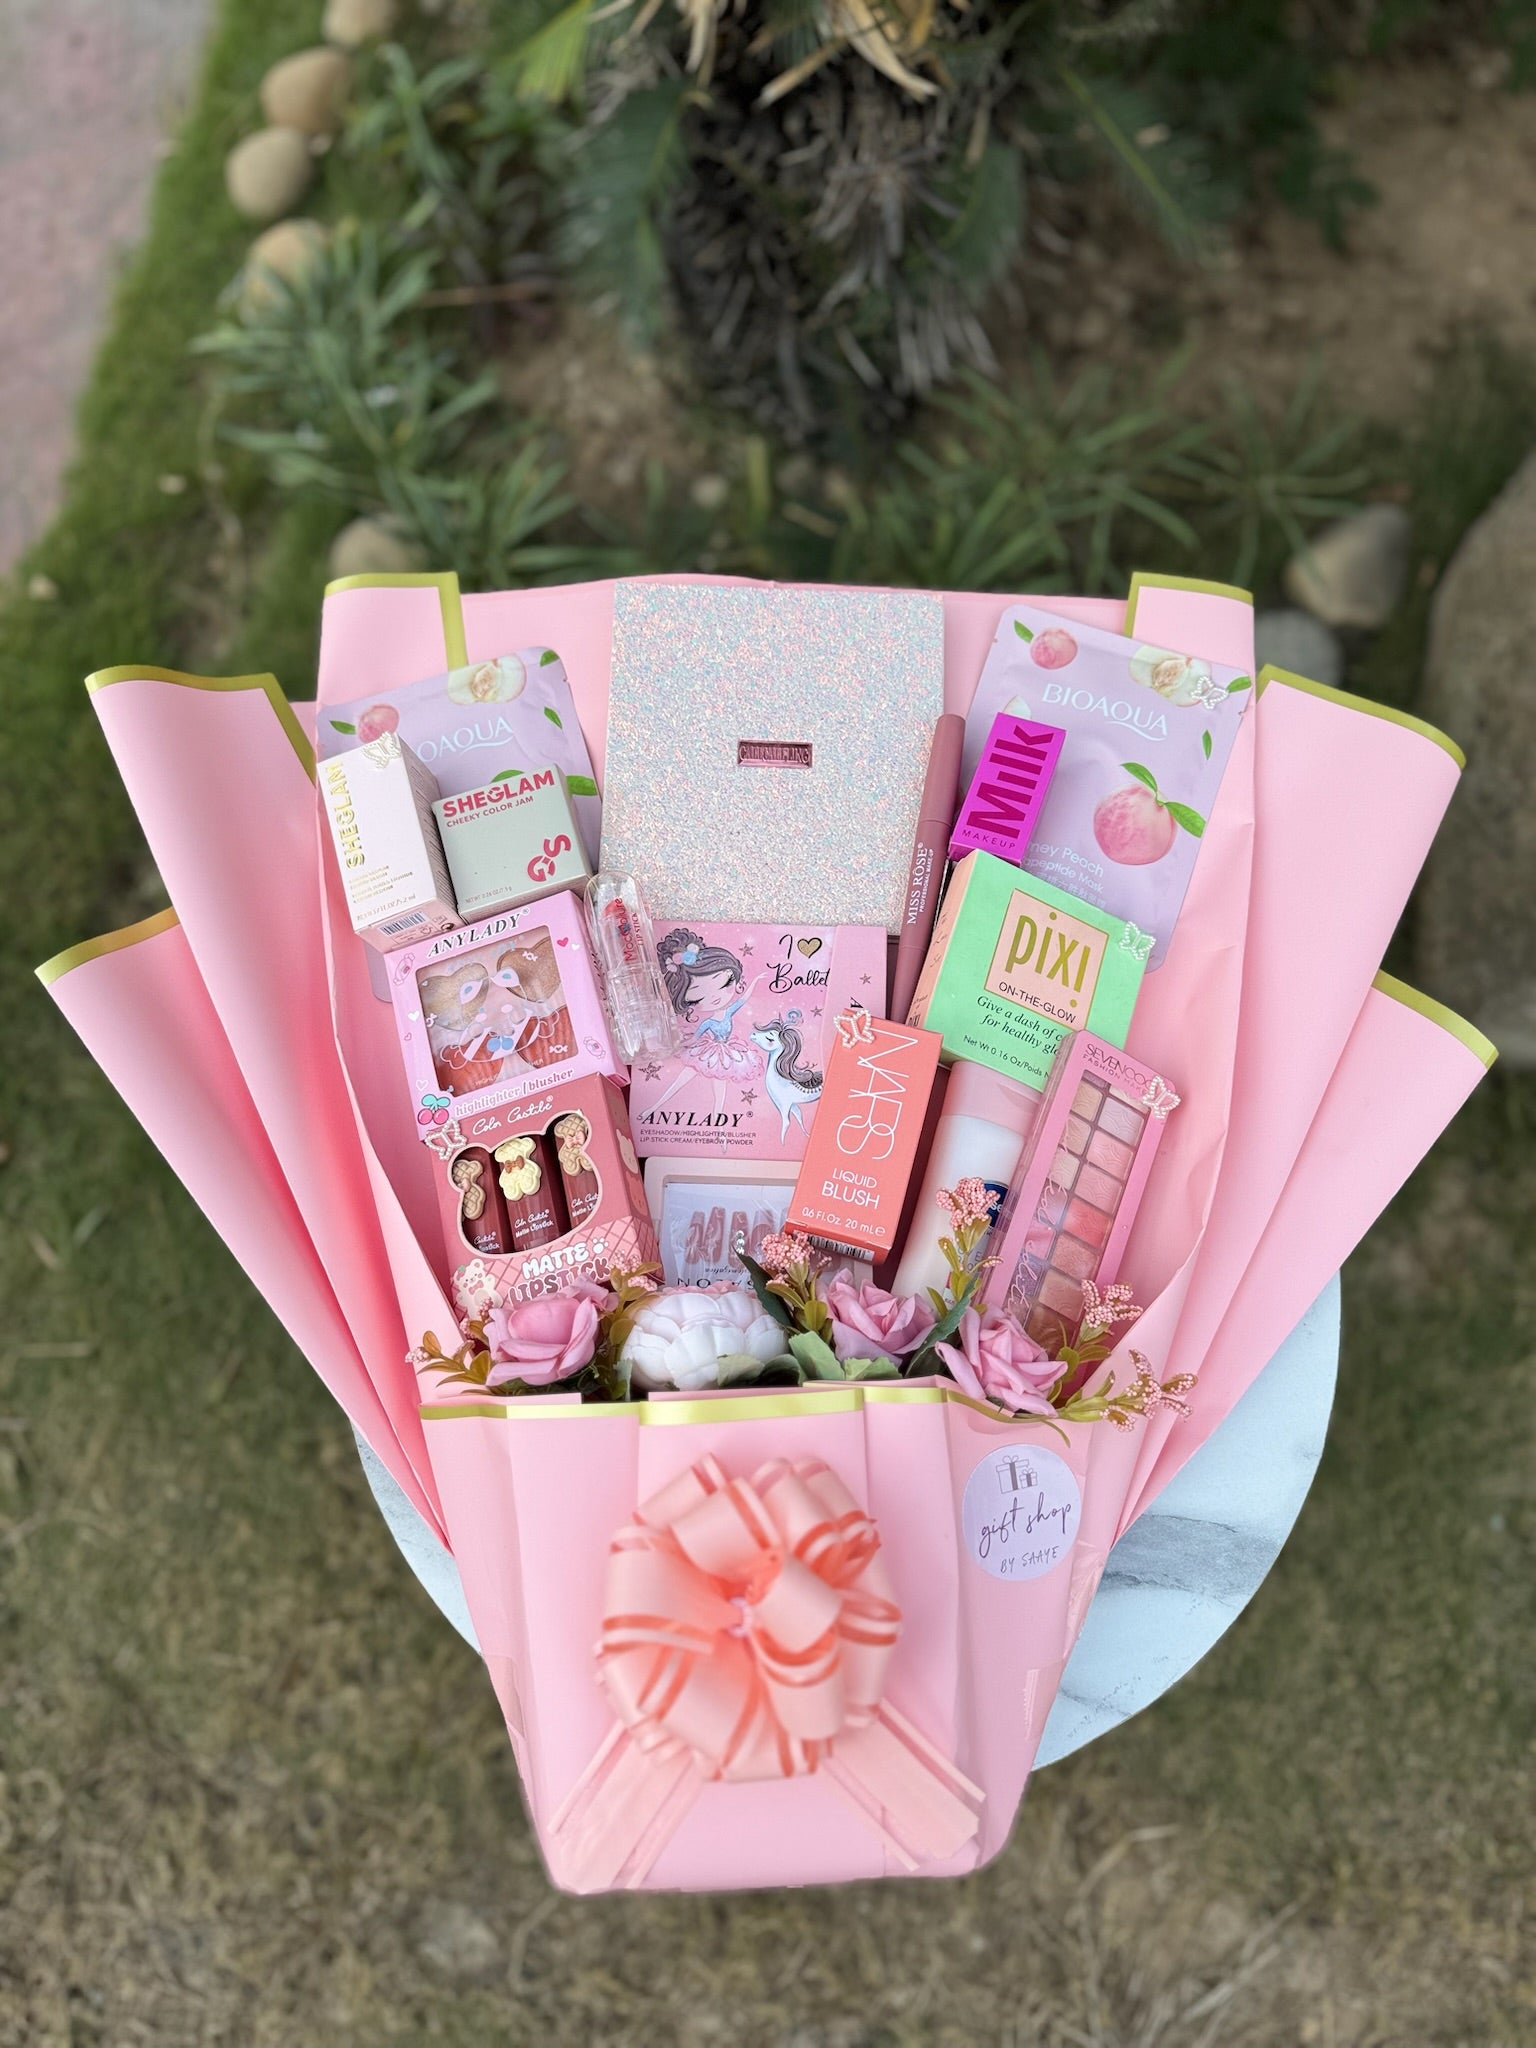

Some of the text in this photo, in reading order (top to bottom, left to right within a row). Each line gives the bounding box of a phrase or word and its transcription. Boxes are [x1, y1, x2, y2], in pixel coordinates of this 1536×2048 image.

[1041, 683, 1168, 737] BIOAQUA
[415, 716, 514, 762] OAQUA
[443, 770, 555, 818] SHEGLAM
[966, 724, 1054, 839] Milk
[325, 760, 365, 869] SHEGLAM
[446, 795, 534, 828] CHEEKY COLOR JAM
[961, 829, 1017, 850] MAKEUP
[1031, 843, 1104, 878] ney Peach
[1079, 872, 1104, 894] Mask
[907, 890, 920, 925] MISS
[427, 913, 522, 958] ANYLADY
[766, 962, 831, 993] Ballet
[977, 995, 1003, 1014] Give
[1004, 1010, 1013, 1019] a
[1014, 1013, 1041, 1032] dash
[1042, 1028, 1057, 1039] of
[998, 981, 1077, 1024] ON-THE-GLOW
[979, 1014, 1001, 1027] for
[1002, 1022, 1042, 1049] healthy
[1042, 1043, 1060, 1055] glo
[963, 1034, 978, 1046] Net
[979, 1041, 990, 1051] Wt
[990, 1047, 1008, 1060] 0.16
[1010, 1056, 1042, 1076] Oz/Poids
[1083, 1054, 1121, 1079] FASHION
[455, 1086, 521, 1117] highlighter
[528, 1068, 574, 1091] blusher
[836, 1027, 919, 1160] NARS
[641, 1111, 743, 1127] ANYLADY
[726, 1138, 754, 1146] POWDER
[821, 1180, 880, 1210] BLUSH
[832, 1167, 877, 1189] LIQUID
[845, 1218, 858, 1229] 20
[522, 1242, 590, 1280] MATTE
[978, 1491, 1072, 1559] gift shop
[1000, 1545, 1060, 1574] BY SAAYE
